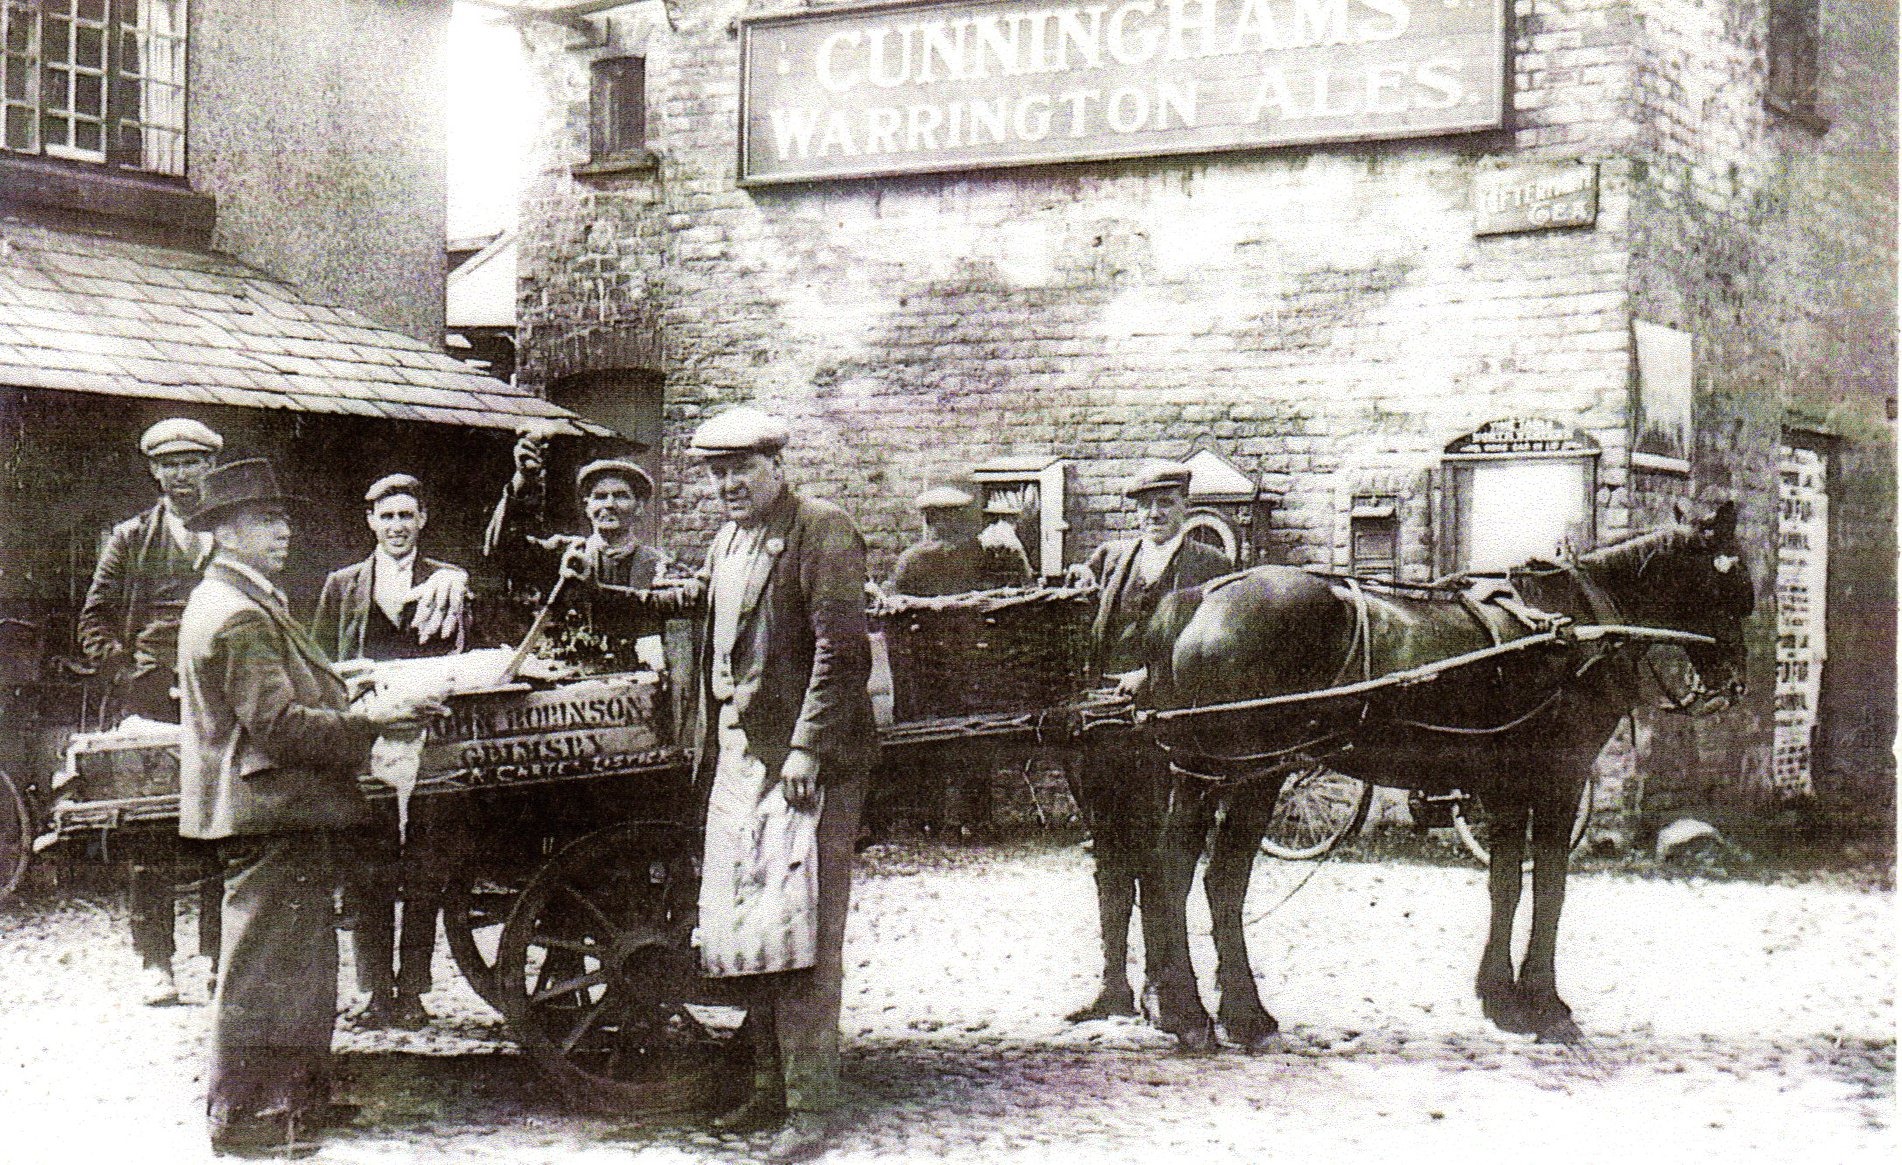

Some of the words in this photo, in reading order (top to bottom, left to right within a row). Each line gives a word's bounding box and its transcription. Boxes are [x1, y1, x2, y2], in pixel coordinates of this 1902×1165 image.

[815, 0, 1411, 92] CUNNINGHAMS
[769, 82, 1201, 161] WARRINGTON
[506, 697, 644, 730] ROBINSON
